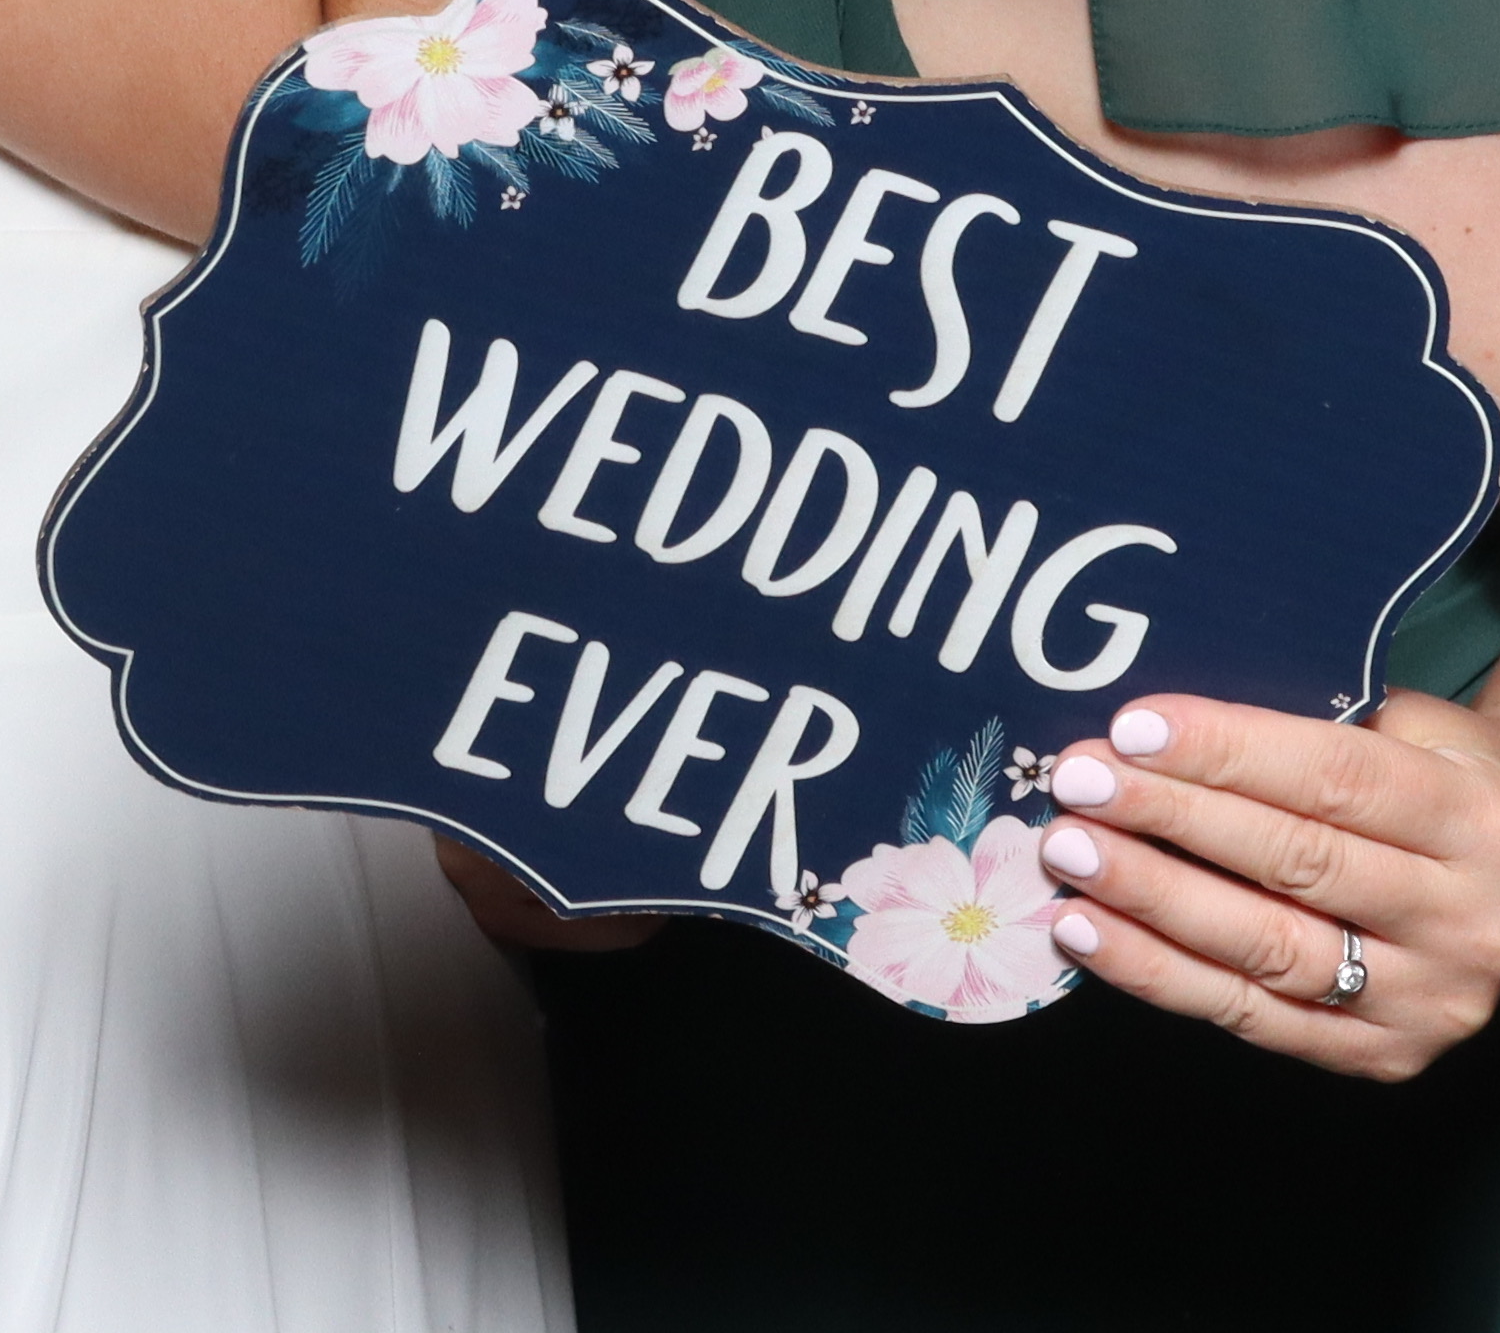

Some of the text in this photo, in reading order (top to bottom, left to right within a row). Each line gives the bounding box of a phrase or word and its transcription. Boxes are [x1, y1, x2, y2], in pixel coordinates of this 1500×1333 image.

[678, 130, 1138, 423] BEST
[393, 318, 1178, 692] WEDDING
[433, 611, 860, 895] EVER
